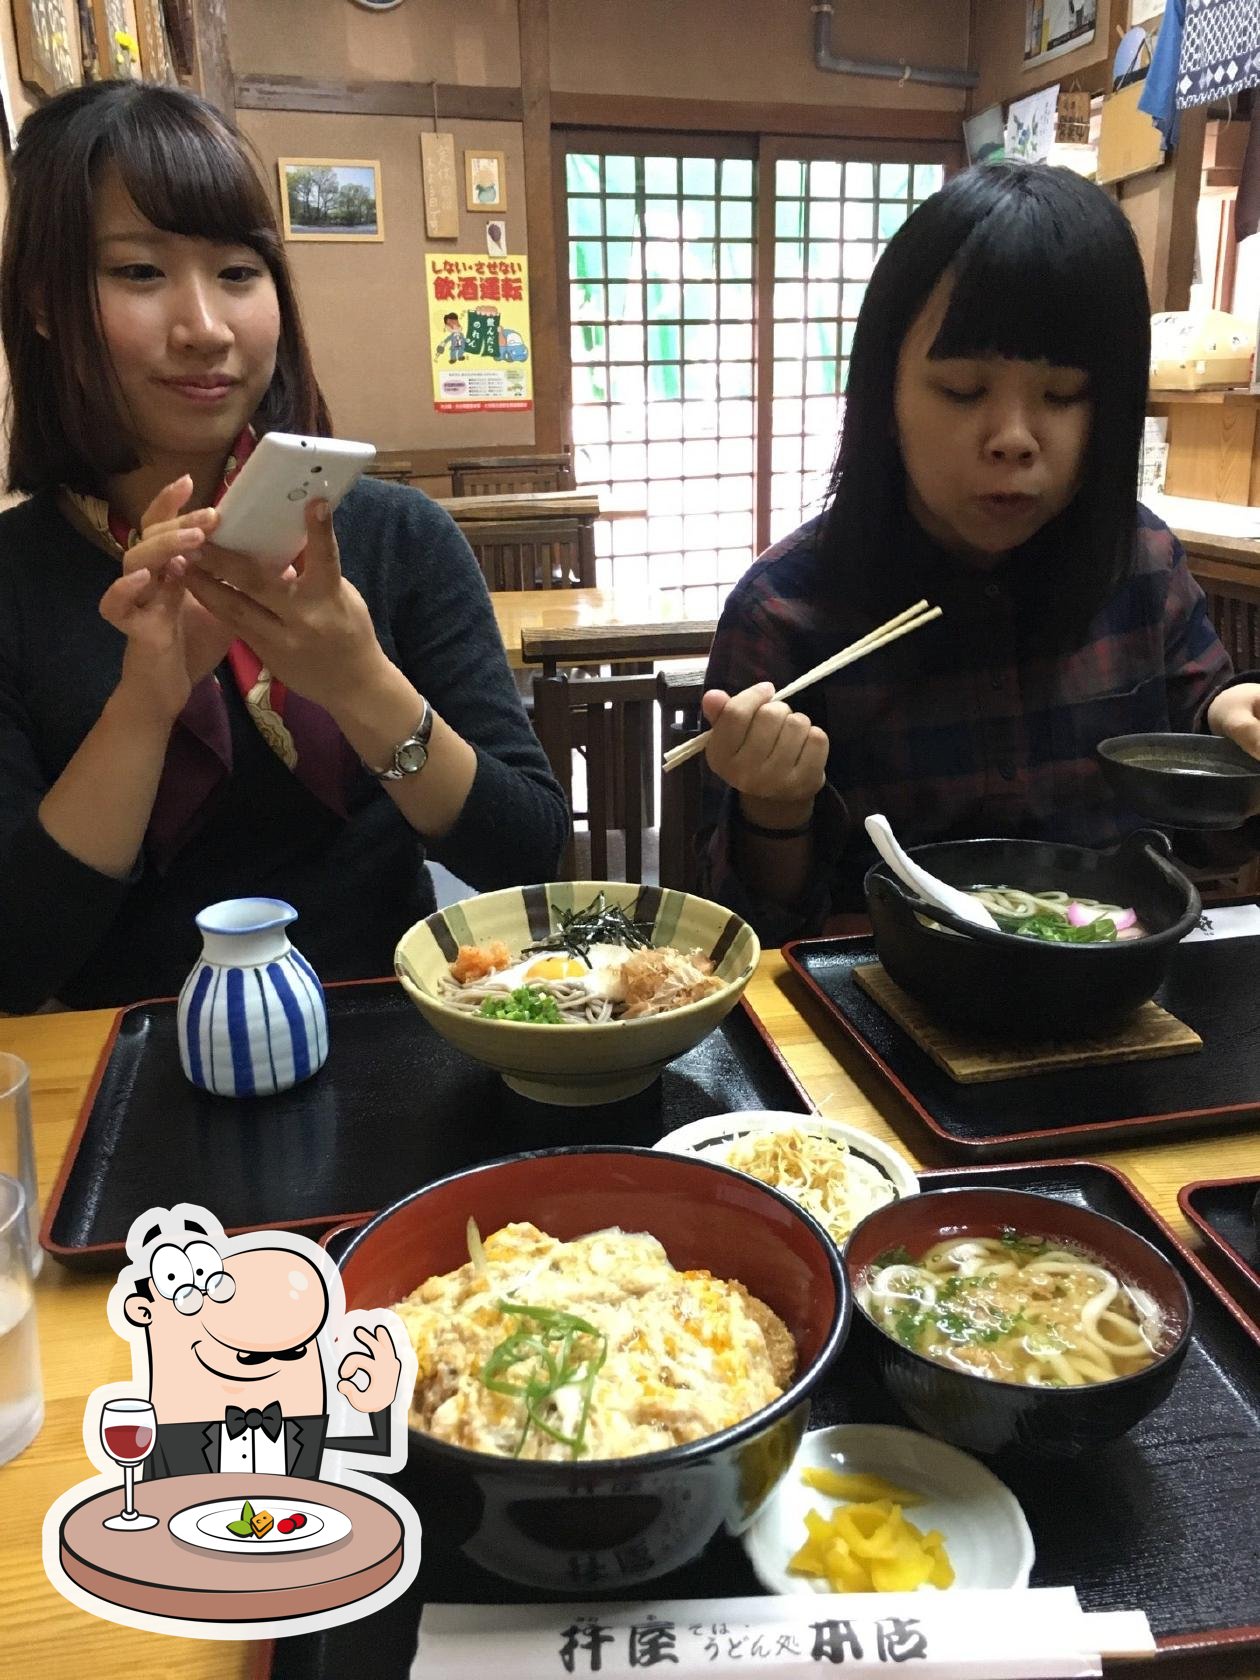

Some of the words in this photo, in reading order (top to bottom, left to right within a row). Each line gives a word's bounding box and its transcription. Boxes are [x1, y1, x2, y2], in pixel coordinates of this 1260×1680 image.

[431, 259, 522, 275] しない・させない
[433, 276, 523, 301] 飲酒運転
